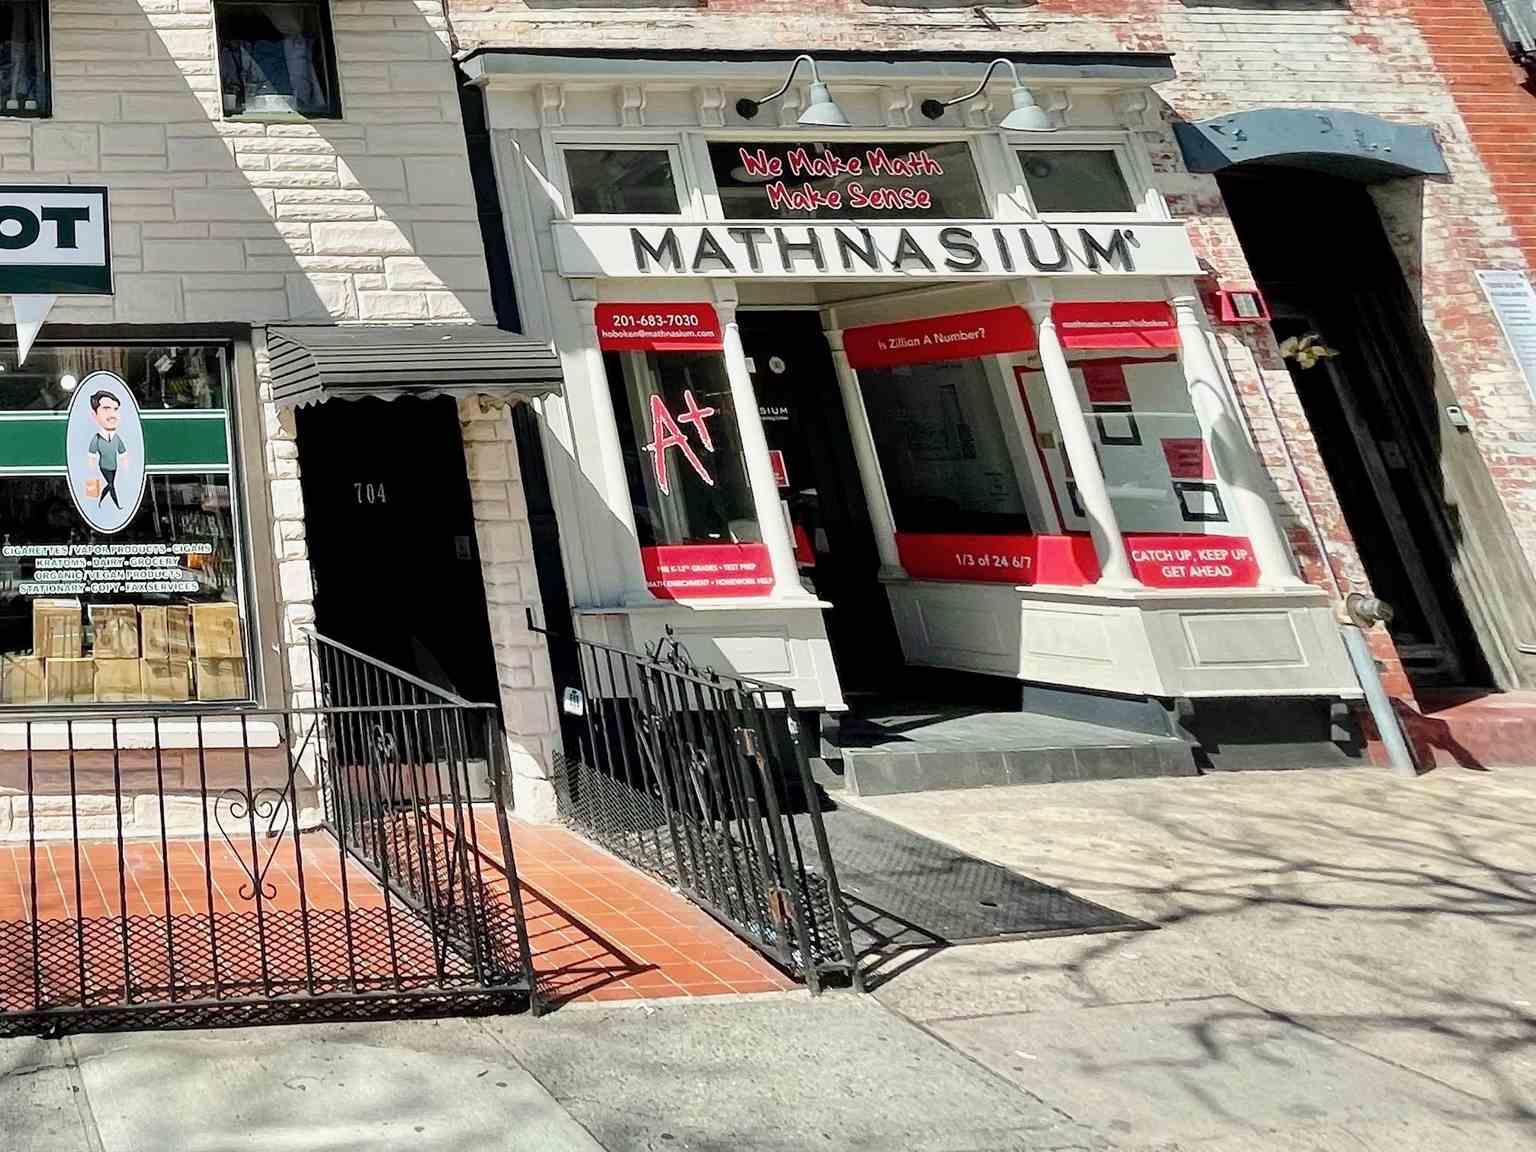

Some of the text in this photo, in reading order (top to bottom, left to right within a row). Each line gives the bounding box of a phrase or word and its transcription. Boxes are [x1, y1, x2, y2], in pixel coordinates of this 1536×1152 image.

[739, 148, 944, 177] We Make Math
[766, 181, 932, 211] Make Sense
[629, 227, 1136, 274] MATHNASIUM
[612, 314, 699, 327] 201-683-7030
[923, 336, 933, 345] A
[934, 327, 986, 344] Number?
[642, 390, 714, 495] A+
[353, 482, 386, 504] 704
[2, 545, 69, 556] CIGARETTES
[110, 543, 166, 555] PRODUCTS
[172, 543, 212, 554] CIGARS
[1131, 549, 1173, 562] CATCH
[1198, 549, 1228, 561] KEEP
[35, 556, 180, 569] KRATOMS DAIRY GROCERY
[956, 554, 1032, 568] 1/3 of 24 6/7
[34, 570, 83, 582] ORGANIC
[125, 569, 182, 580] PRODUCTS
[1162, 565, 1232, 577] GET AHEAD
[90, 582, 122, 593] COPY
[125, 582, 147, 593] FAX
[146, 581, 200, 593] SERVICES
